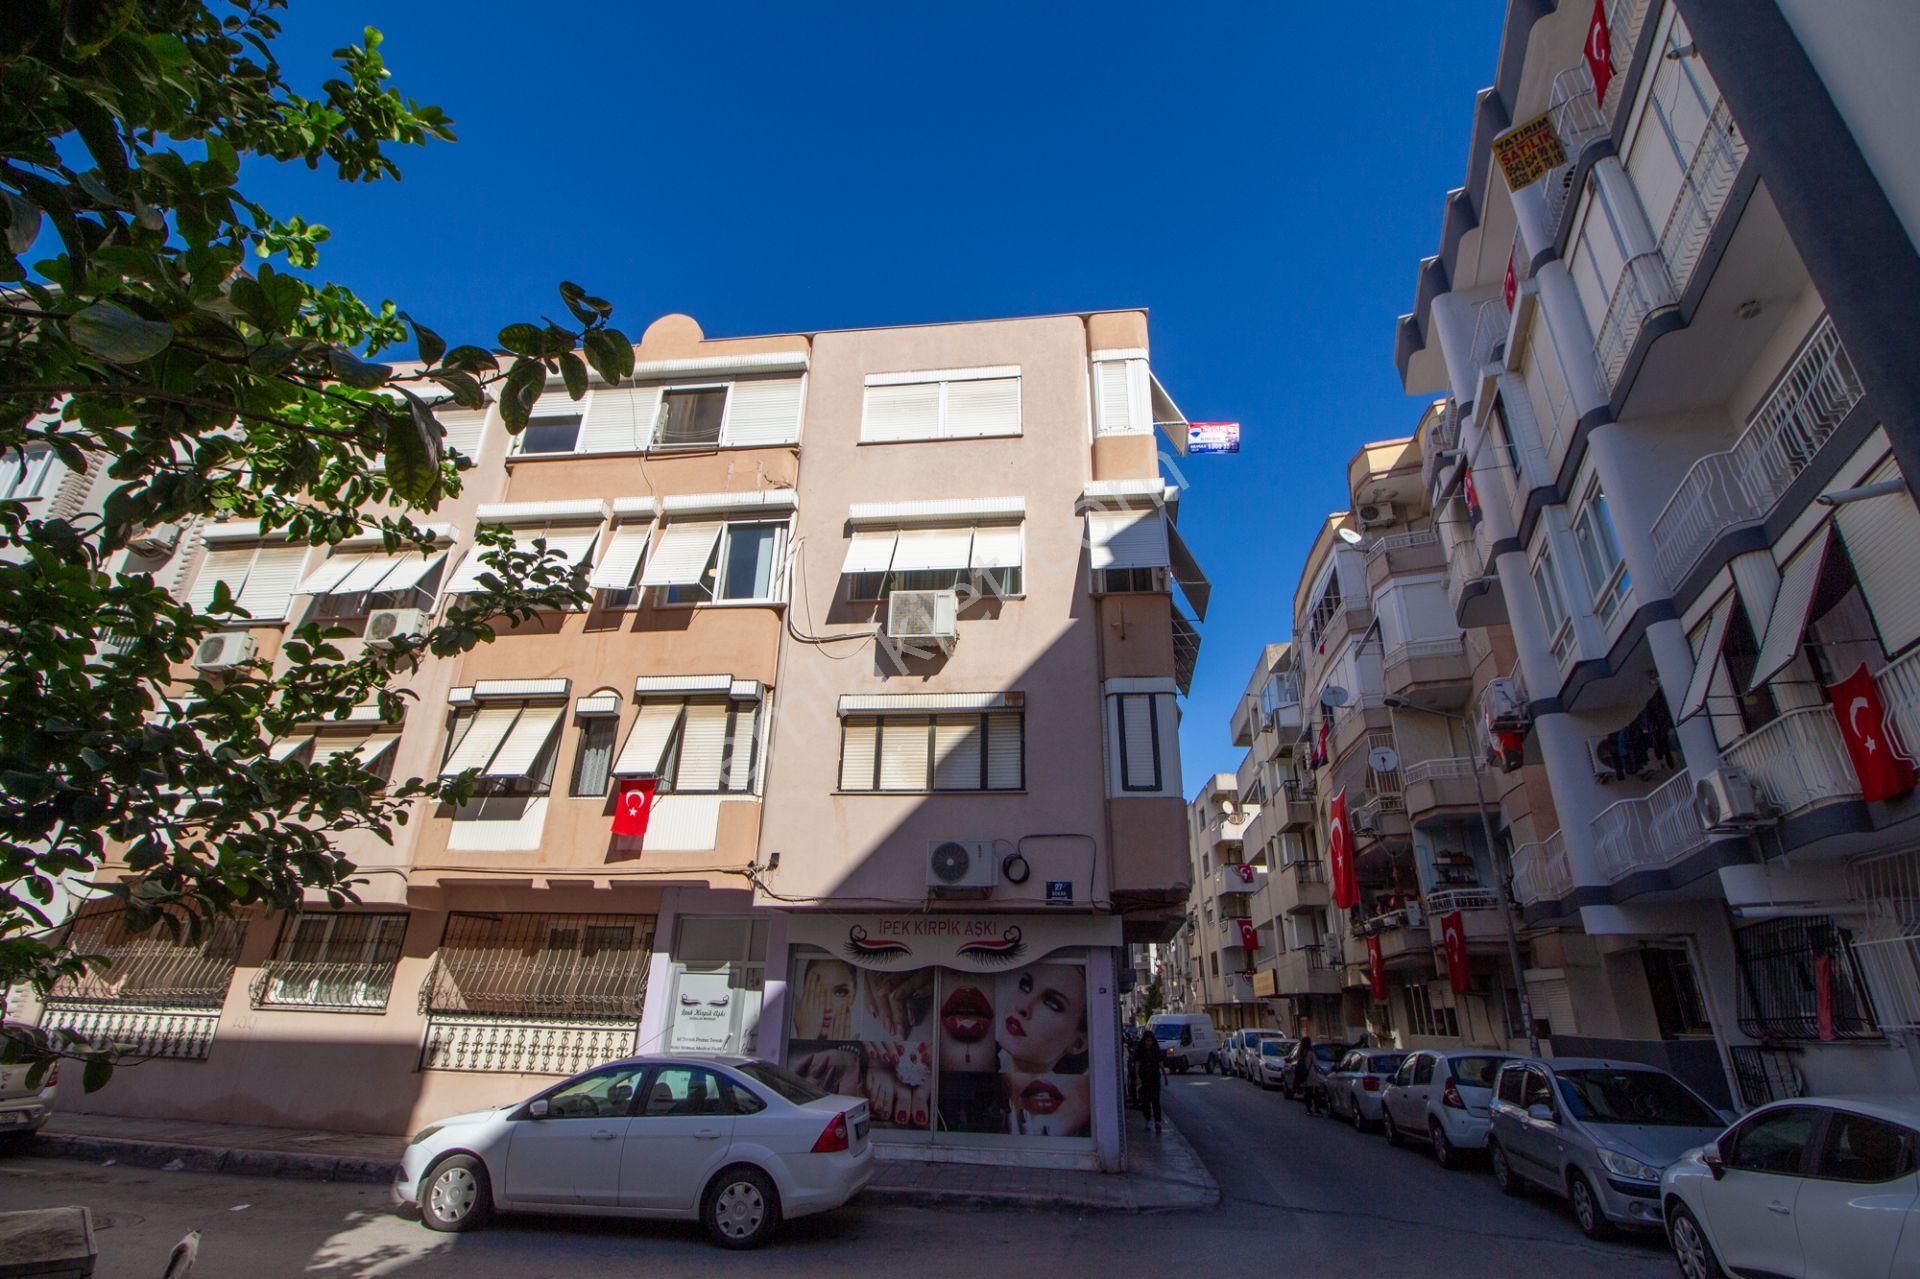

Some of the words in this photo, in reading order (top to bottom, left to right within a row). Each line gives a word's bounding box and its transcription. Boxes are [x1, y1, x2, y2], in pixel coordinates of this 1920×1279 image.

[1495, 117, 1549, 149] YATIRIM
[879, 918, 910, 936] İPEK
[914, 918, 961, 936] KİRPİK
[964, 919, 997, 937] AŞKI
